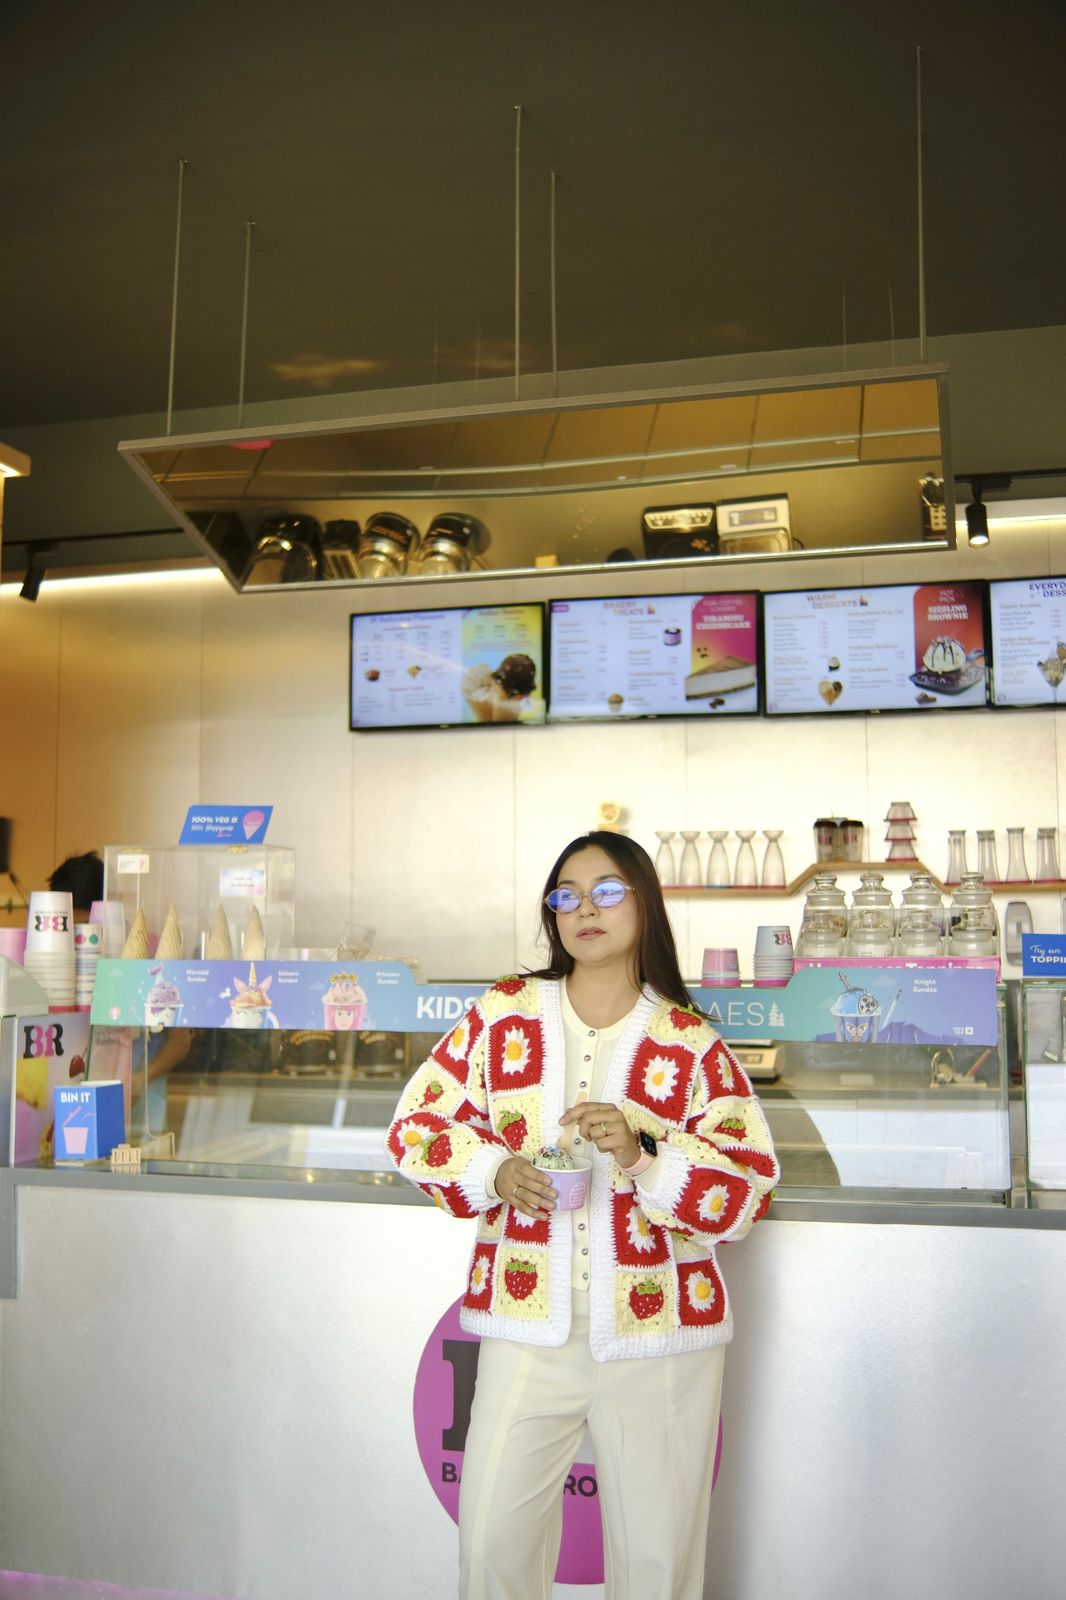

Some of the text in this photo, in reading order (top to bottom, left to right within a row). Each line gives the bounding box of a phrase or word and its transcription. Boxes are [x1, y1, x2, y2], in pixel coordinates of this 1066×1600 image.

[1030, 944, 1045, 957] Try
[913, 979, 936, 987] Knight
[60, 1092, 91, 1103] BIN IT
